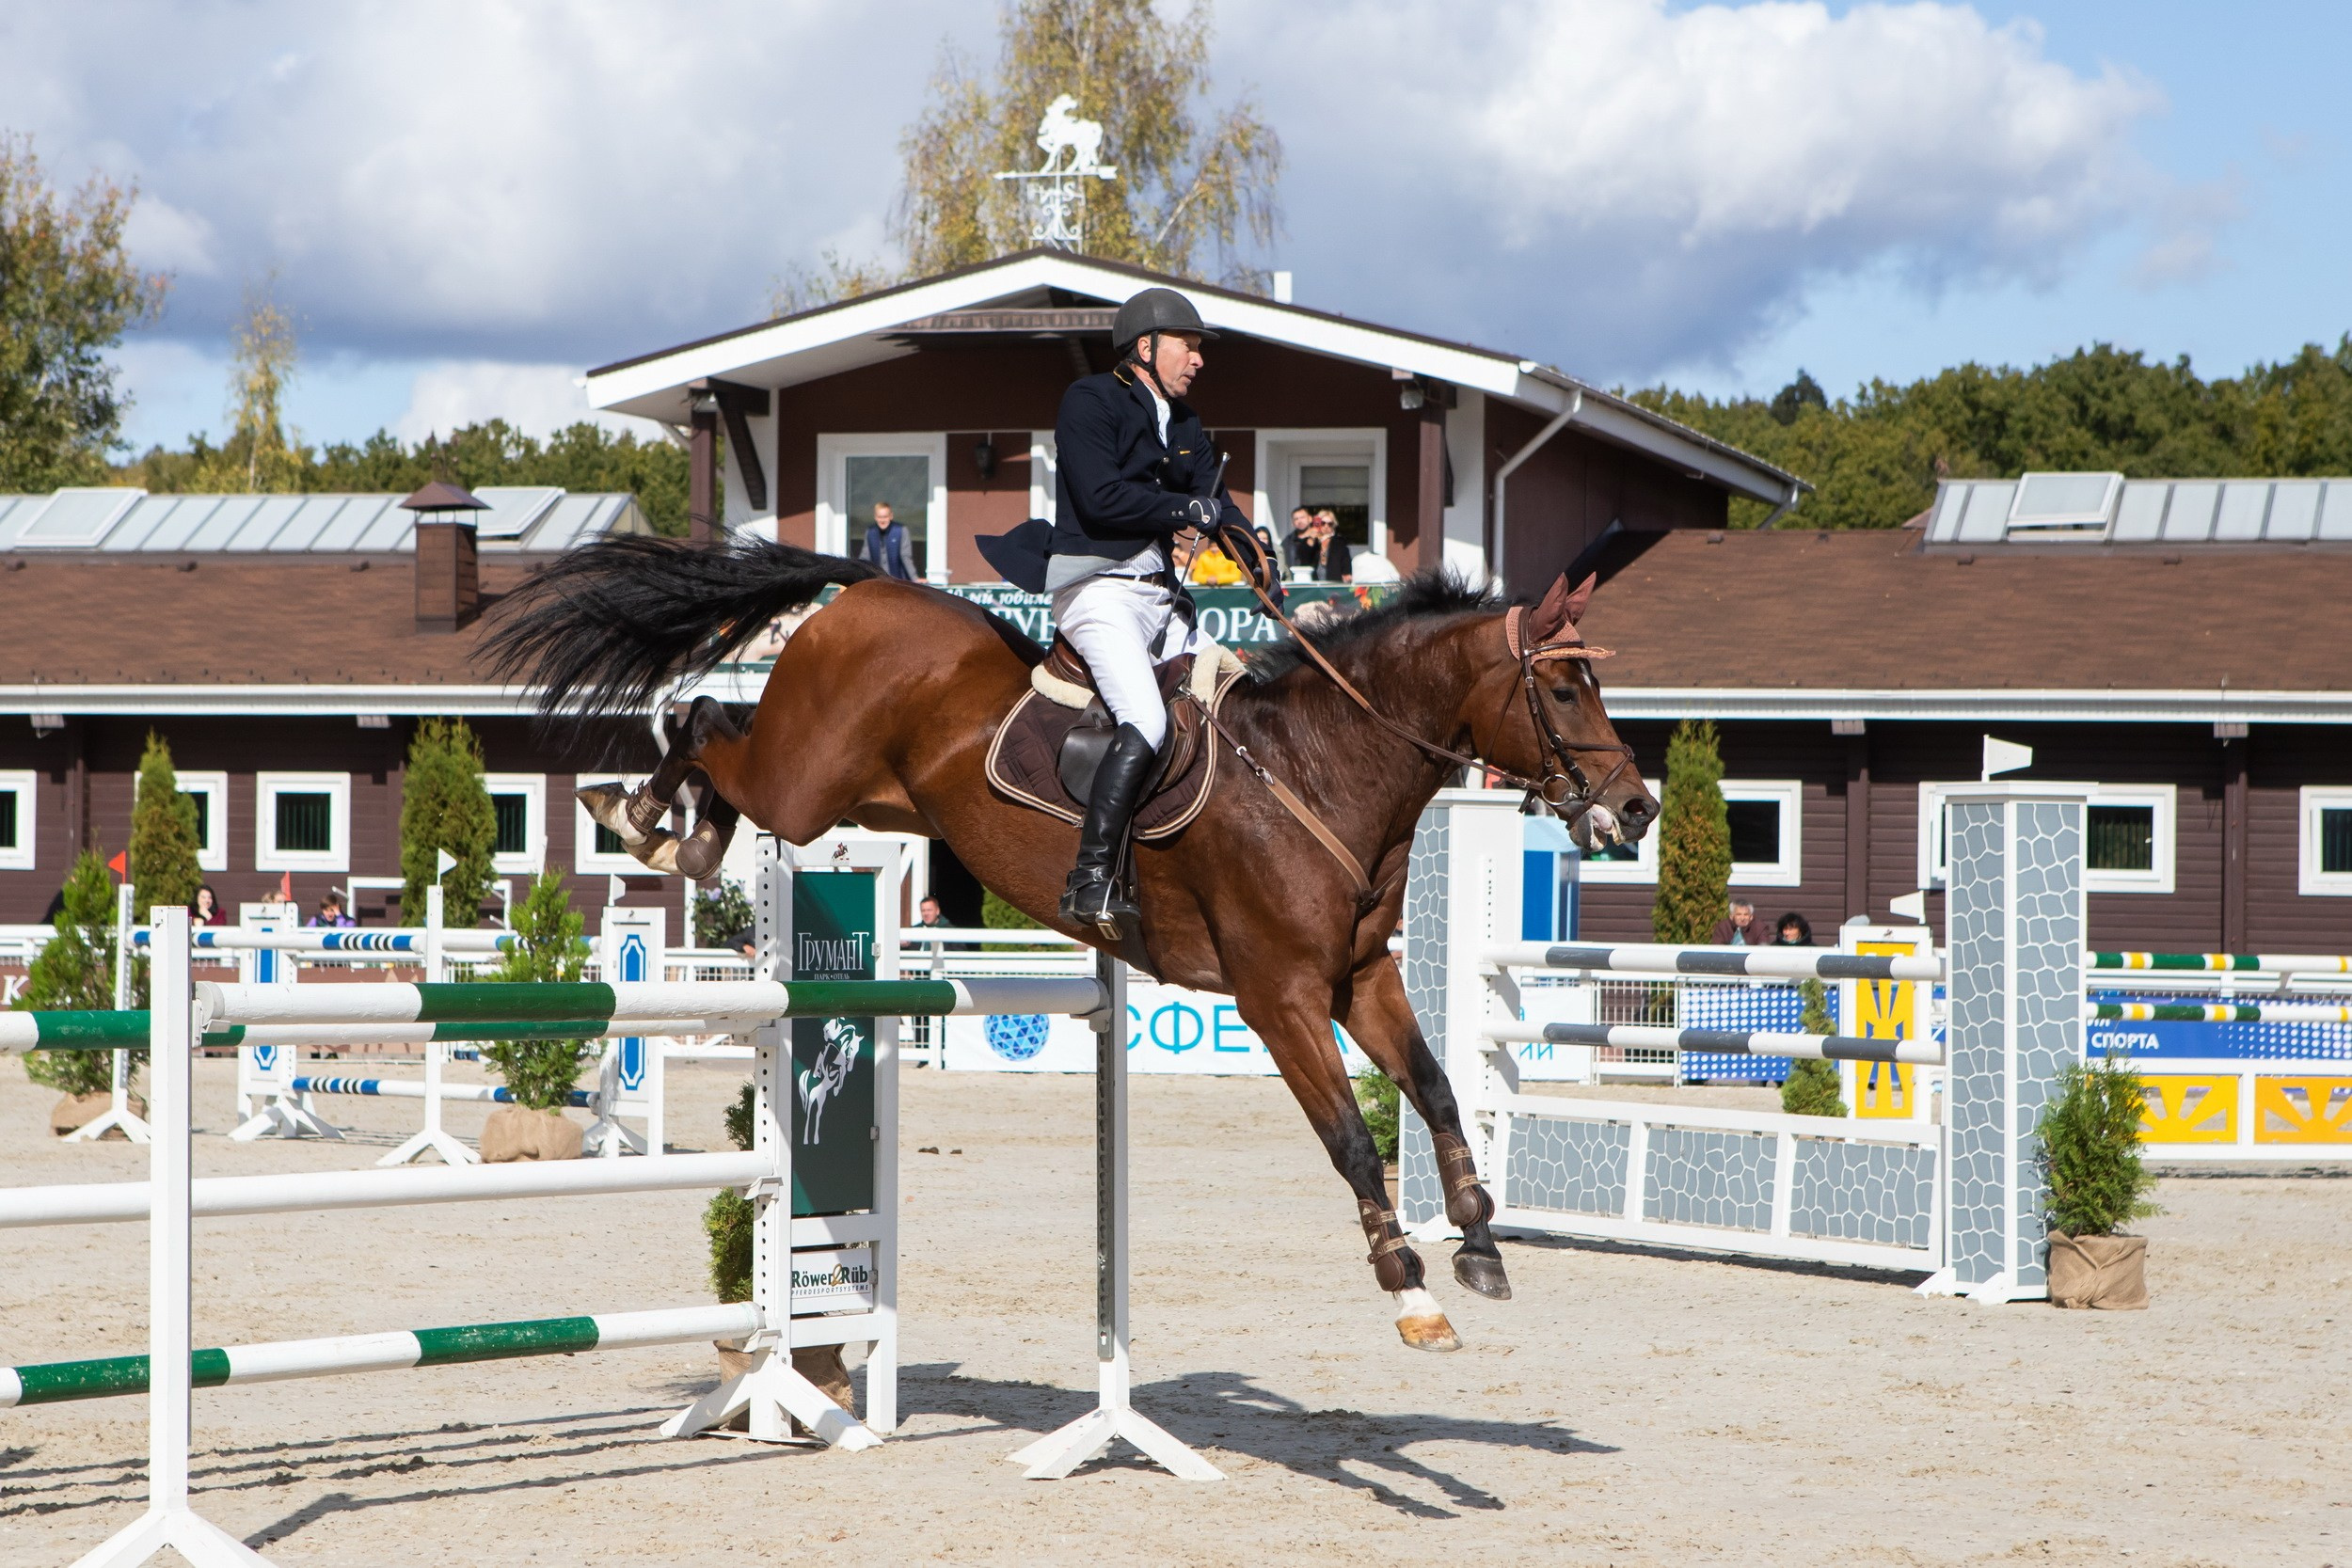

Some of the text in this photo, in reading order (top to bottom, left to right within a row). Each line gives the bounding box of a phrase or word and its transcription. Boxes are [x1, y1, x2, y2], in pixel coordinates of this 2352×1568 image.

[999, 590, 1053, 605] юбиле
[797, 931, 869, 971] ГРУМАНТ
[2091, 1032, 2160, 1050] СПОРТА
